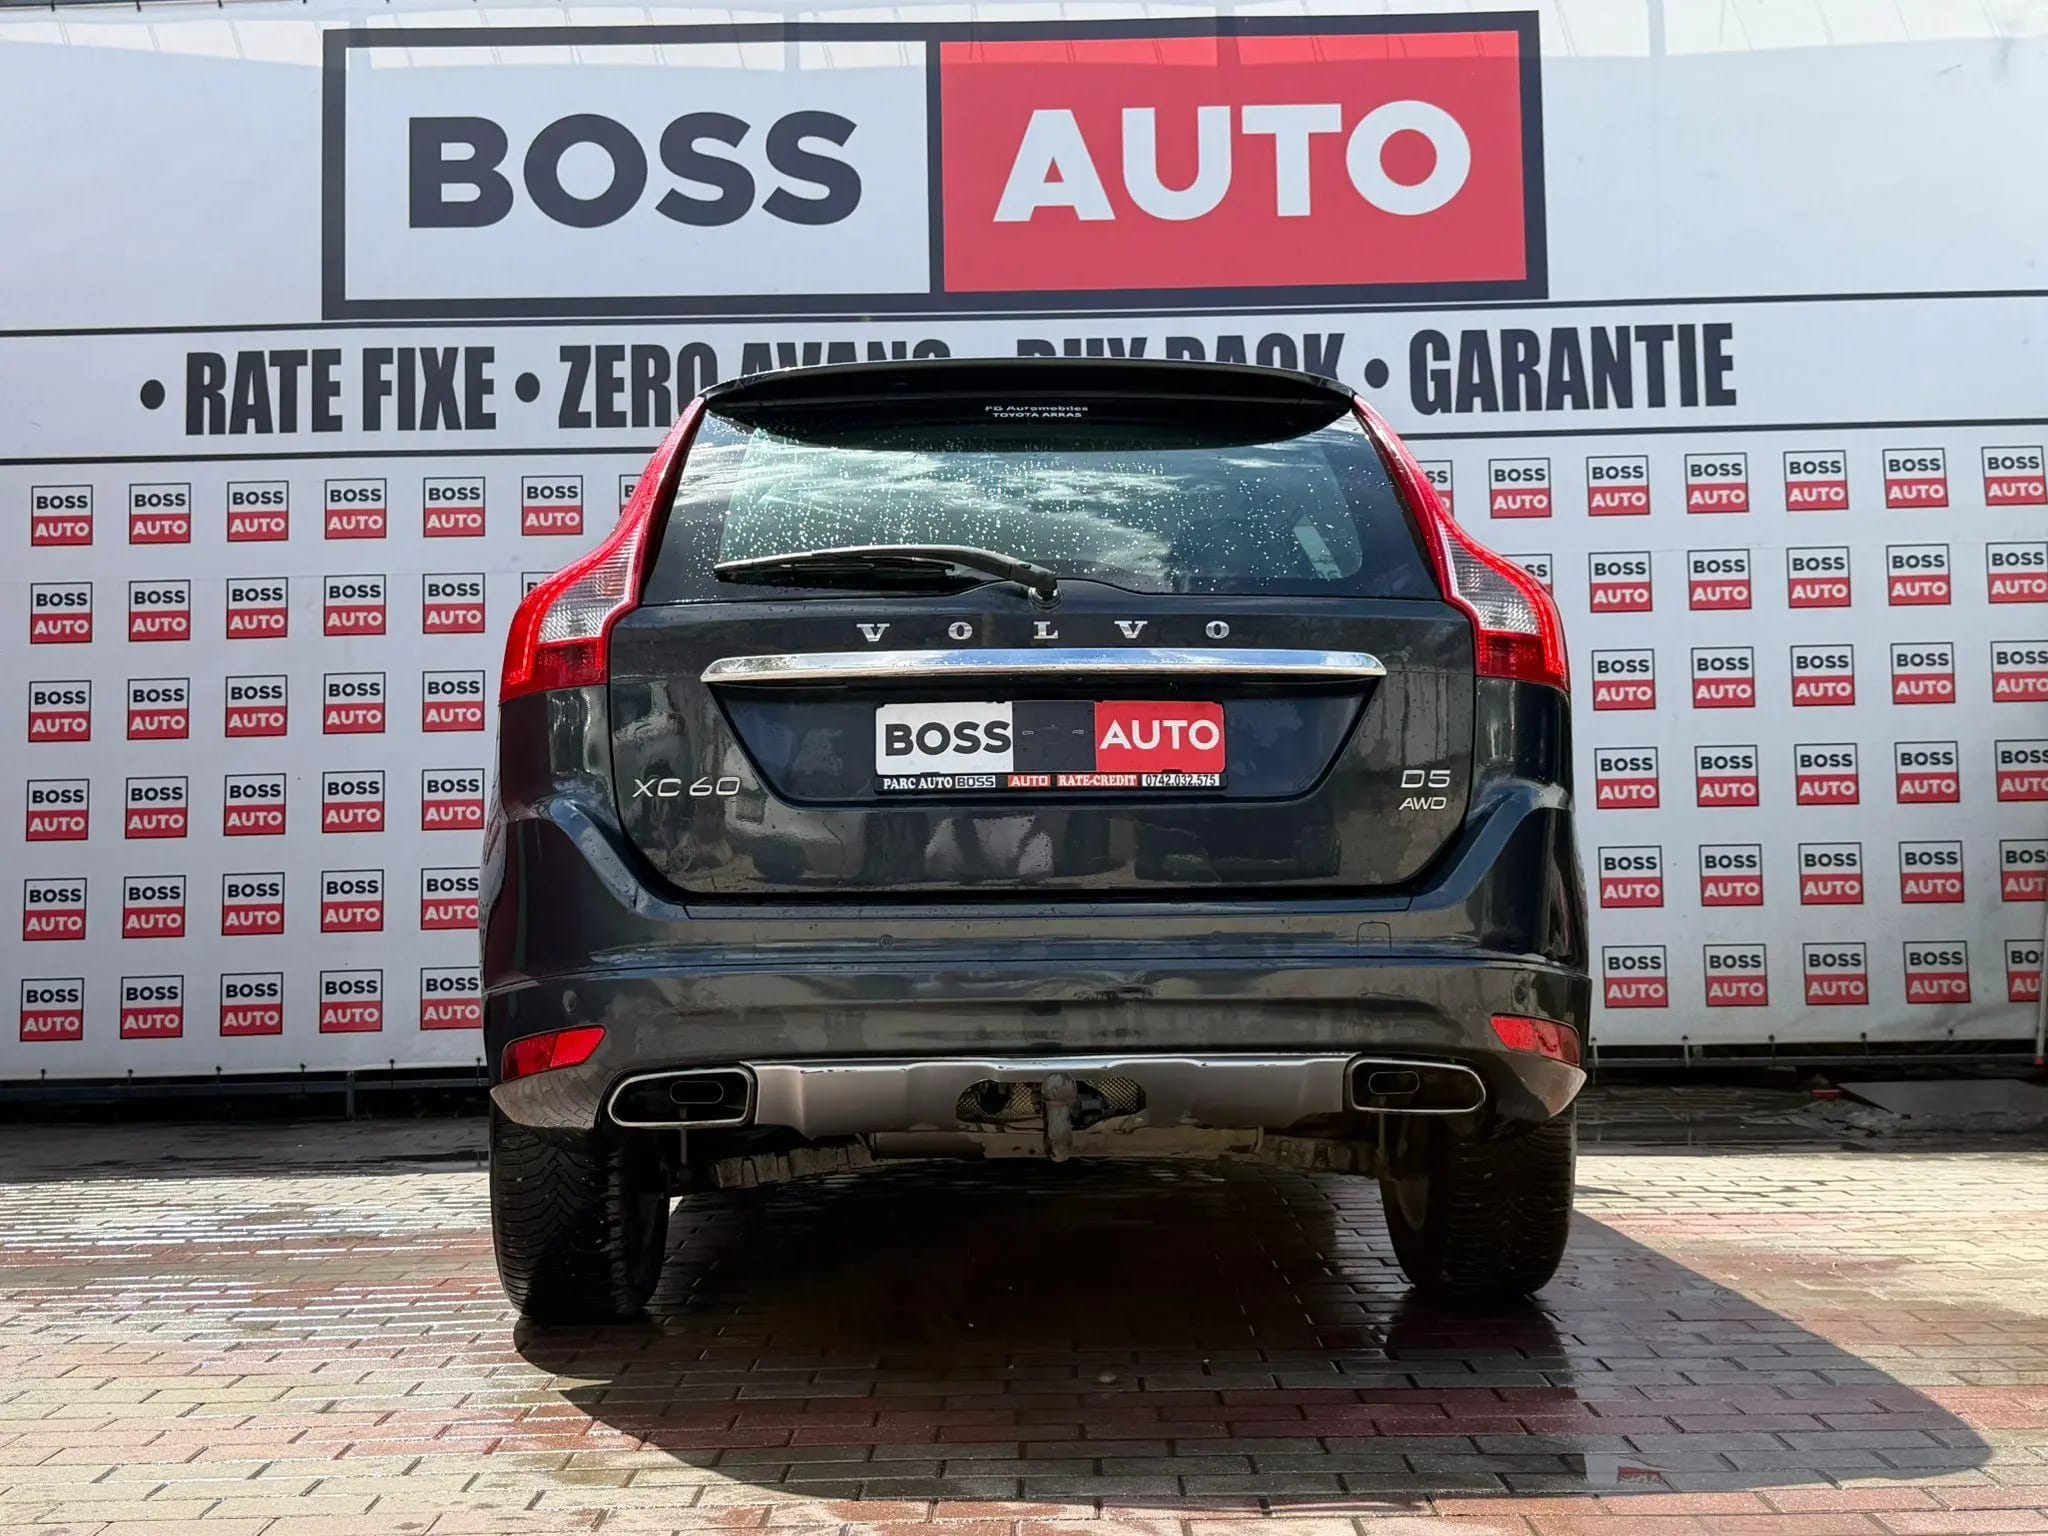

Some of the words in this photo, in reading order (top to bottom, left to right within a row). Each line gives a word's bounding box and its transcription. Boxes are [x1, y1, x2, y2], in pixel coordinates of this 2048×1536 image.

[409, 110, 862, 228] BOSS
[993, 99, 1471, 222] AUTO
[185, 348, 342, 436] RATE
[362, 346, 496, 431] FIXE
[558, 341, 718, 429] ZERO
[1408, 322, 1737, 416] GARANTIE
[1790, 461, 1841, 474] BOSS
[1891, 458, 1943, 471] BOSS
[1989, 456, 2039, 469] BOSS
[1495, 468, 1545, 482] BOSS
[1593, 466, 1643, 479] BOSS
[1691, 463, 1742, 477] BOSS
[331, 489, 381, 502] BOSS
[429, 487, 480, 500] BOSS
[527, 486, 578, 499] BOSS
[1790, 487, 1845, 501] AUTO
[1889, 485, 1944, 499] AUTO
[1989, 483, 2043, 496] AUTO
[37, 496, 87, 509] BOSS
[135, 494, 185, 507] BOSS
[233, 491, 283, 505] BOSS
[1494, 495, 1548, 509] AUTO
[1592, 493, 1646, 507] AUTO
[1690, 490, 1745, 504] AUTO
[231, 518, 285, 532] AUTO
[328, 516, 383, 530] AUTO
[427, 514, 481, 528] AUTO
[526, 513, 579, 526] AUTO
[35, 523, 89, 537] AUTO
[133, 521, 187, 534] AUTO
[1793, 557, 1844, 571] BOSS
[1893, 555, 1944, 568] BOSS
[1993, 552, 2044, 566] BOSS
[1595, 562, 1646, 575] BOSS
[1694, 560, 1745, 573] BOSS
[330, 585, 381, 598] BOSS
[429, 583, 480, 596] BOSS
[1693, 587, 1748, 601] AUTO
[1792, 584, 1847, 598] AUTO
[1892, 582, 1947, 596] AUTO
[1992, 580, 2047, 594] AUTO
[37, 593, 87, 606] BOSS
[135, 591, 185, 604] BOSS
[233, 588, 283, 602] BOSS
[1594, 589, 1648, 603] AUTO
[230, 615, 284, 629] AUTO
[328, 612, 382, 626] AUTO
[427, 610, 481, 624] AUTO
[34, 620, 89, 634] AUTO
[133, 618, 187, 632] AUTO
[856, 620, 1230, 642] VOLVO
[1697, 657, 1749, 671] BOSS
[1797, 655, 1848, 669] BOSS
[1897, 653, 1948, 667] BOSS
[1997, 651, 2048, 664] BOSS
[1598, 660, 1649, 673] BOSS
[231, 686, 282, 700] BOSS
[329, 683, 380, 697] BOSS
[428, 681, 480, 694] BOSS
[1596, 687, 1652, 701] AUTO
[1696, 685, 1751, 698] AUTO
[1796, 683, 1851, 697] AUTO
[1896, 680, 1952, 694] AUTO
[35, 691, 86, 705] BOSS
[133, 689, 184, 702] BOSS
[229, 713, 284, 727] AUTO
[327, 710, 382, 724] AUTO
[426, 708, 481, 722] AUTO
[32, 718, 87, 732] AUTO
[131, 716, 185, 730] AUTO
[885, 720, 1012, 756] BOSS
[1099, 719, 1220, 750] AUTO
[1601, 758, 1653, 771] BOSS
[1701, 756, 1752, 769] BOSS
[1801, 754, 1852, 767] BOSS
[1901, 752, 1953, 766] BOSS
[883, 777, 916, 790] PARC
[918, 776, 953, 789] AUTO
[957, 776, 994, 787] BOSS
[1011, 775, 1048, 787] AUTO
[1058, 774, 1137, 786] RATE-CREDIT
[1400, 769, 1451, 788] D5
[230, 784, 281, 798] BOSS
[328, 781, 379, 795] BOSS
[428, 779, 479, 793] BOSS
[1600, 785, 1655, 799] AUTO
[1700, 783, 1755, 797] AUTO
[1800, 781, 1855, 795] AUTO
[1900, 780, 1956, 794] AUTO
[33, 790, 84, 803] BOSS
[131, 787, 183, 801] BOSS
[1398, 796, 1447, 811] AWD
[227, 812, 282, 826] AUTO
[326, 809, 380, 823] AUTO
[425, 807, 480, 820] AUTO
[30, 817, 85, 831] AUTO
[128, 815, 184, 829] AUTO
[1605, 857, 1656, 870] BOSS
[1705, 855, 1757, 868] BOSS
[1805, 853, 1857, 867] BOSS
[1905, 852, 1957, 865] BOSS
[2006, 850, 2047, 863] BOS
[228, 883, 279, 897] BOSS
[327, 880, 378, 894] BOSS
[427, 878, 478, 892] BOSS
[1604, 884, 1659, 898] AUTO
[1704, 883, 1759, 896] AUTO
[1804, 881, 1859, 895] AUTO
[1905, 880, 1960, 894] AUTO
[2005, 878, 2045, 891] AUT
[30, 889, 81, 903] BOSS
[129, 886, 180, 900] BOSS
[225, 911, 280, 926] AUTO
[324, 908, 380, 923] AUTO
[425, 906, 479, 920] AUTO
[27, 917, 82, 931] AUTO
[126, 914, 181, 928] AUTO
[1609, 956, 1661, 969] BOSS
[1710, 955, 1761, 968] BOSS
[1810, 953, 1861, 967] BOSS
[1910, 952, 1963, 965] BOSS
[226, 983, 278, 998] BOSS
[326, 980, 377, 995] BOSS
[426, 977, 478, 991] BOSS
[1608, 984, 1664, 998] AUTO
[1710, 983, 1764, 997] AUTO
[1809, 981, 1864, 995] AUTO
[1910, 980, 1966, 994] AUTO
[27, 989, 78, 1003] BOSS
[127, 986, 178, 1000] BOSS
[224, 1011, 279, 1026] AUTO
[323, 1008, 379, 1023] AUTO
[424, 1005, 480, 1020] AUTO
[24, 1017, 79, 1031] AUTO
[124, 1014, 179, 1029] AUTO
